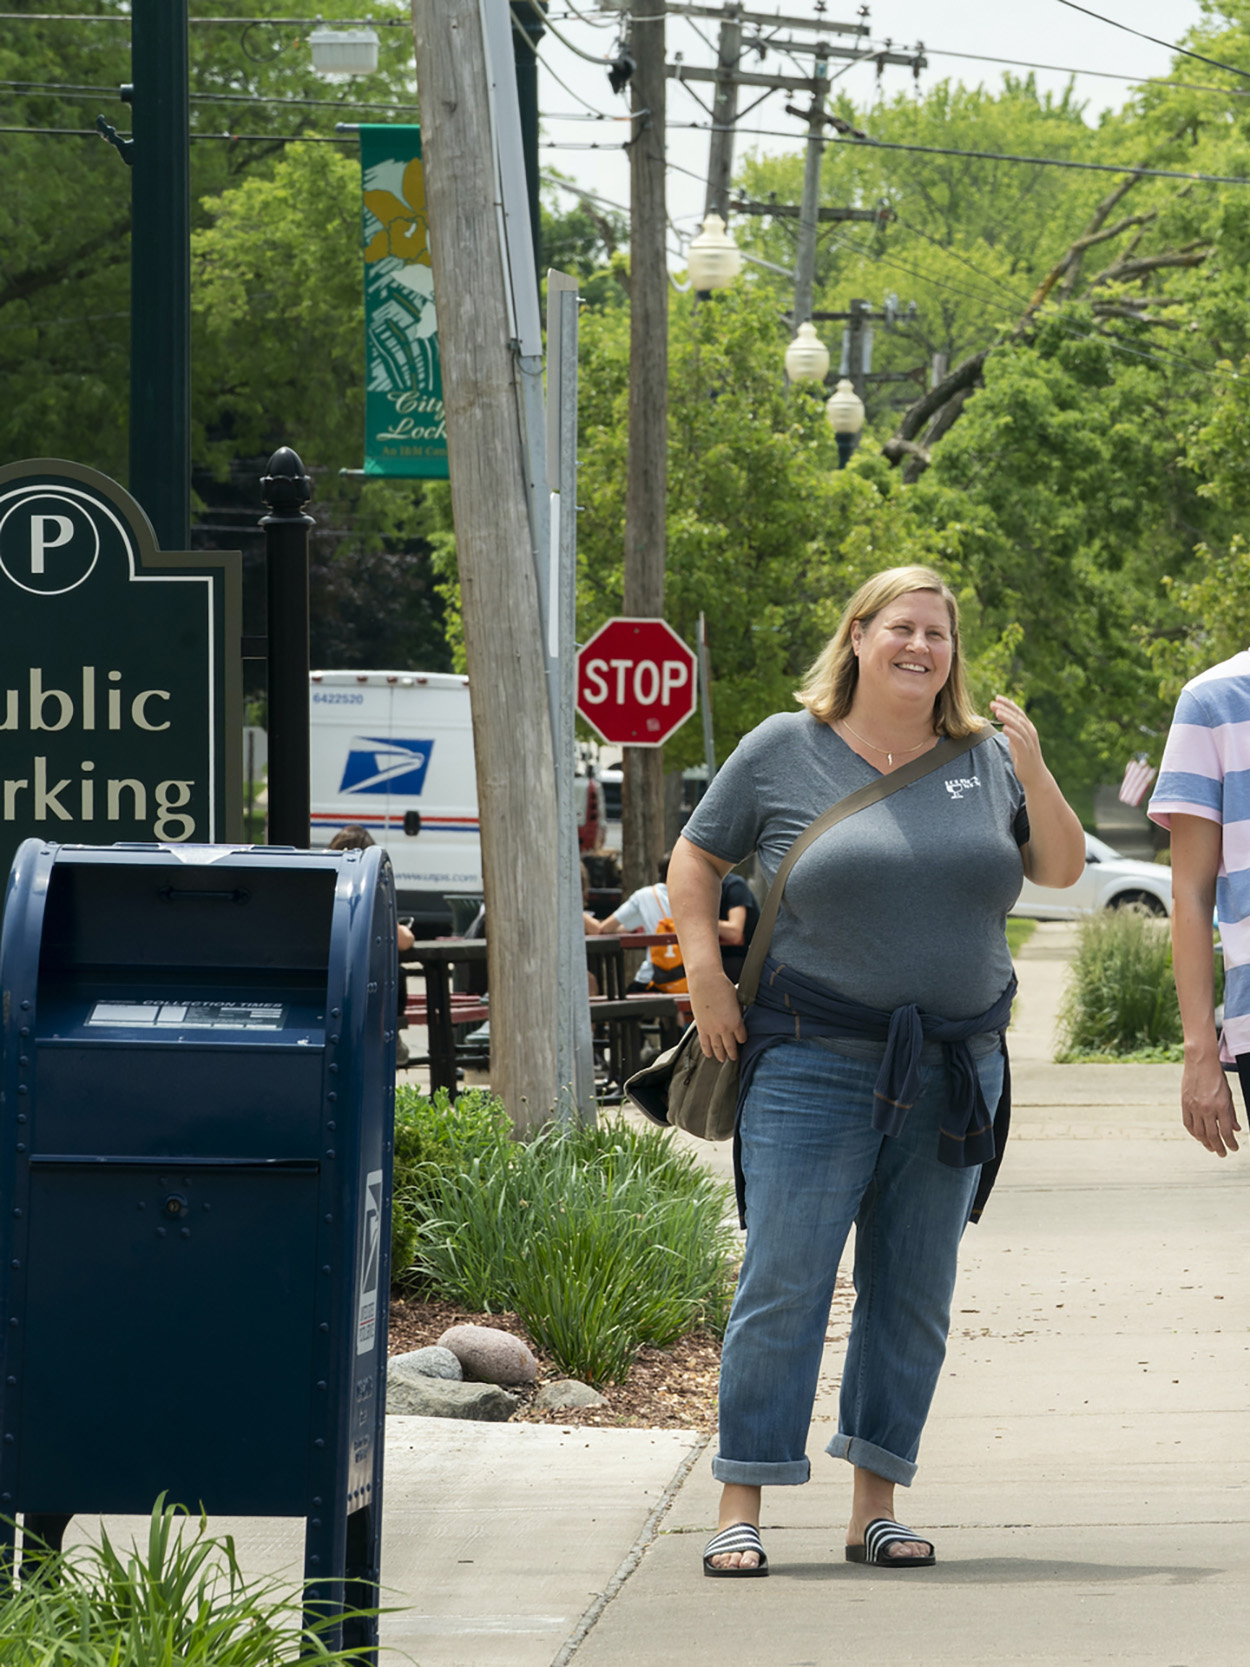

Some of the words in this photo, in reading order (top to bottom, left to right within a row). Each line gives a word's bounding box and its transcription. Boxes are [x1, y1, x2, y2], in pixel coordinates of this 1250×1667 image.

[387, 391, 446, 421] City
[376, 417, 448, 441] Lock
[30, 515, 75, 574] P
[583, 658, 689, 706] STOP
[4, 756, 196, 842] rking
[142, 1000, 235, 1008] COLLECTION
